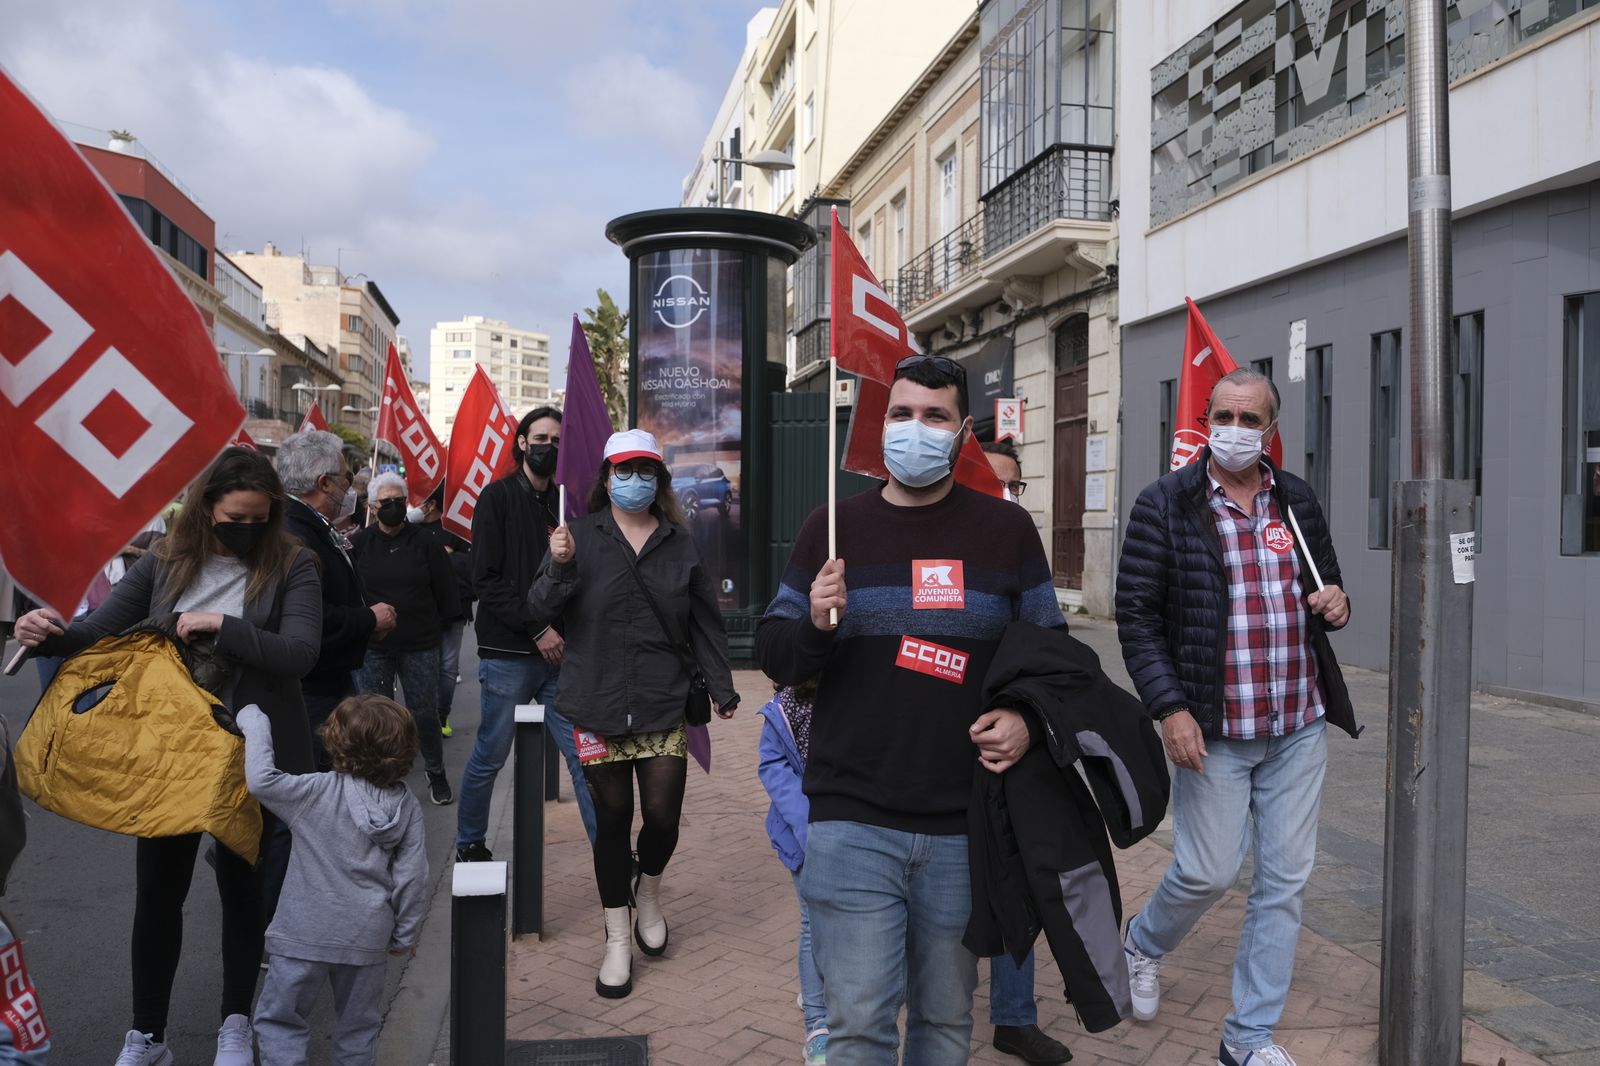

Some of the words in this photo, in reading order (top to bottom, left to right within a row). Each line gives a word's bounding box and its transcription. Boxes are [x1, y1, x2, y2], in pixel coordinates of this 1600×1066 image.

[653, 297, 710, 308] NISSAN
[659, 366, 700, 378] NUEVO
[641, 379, 671, 391] NISSAN
[674, 378, 730, 389] QASHQAI
[1266, 527, 1287, 541] UGT
[917, 588, 960, 596] JUVENTUD
[901, 639, 966, 672] CCOO
[934, 666, 961, 679] ALMERÍA
[578, 747, 607, 758] COMUNISTA
[580, 743, 604, 753] JUVENTUD
[0, 945, 47, 1044] CCOO
[4, 1009, 29, 1050] ALMERÍA
